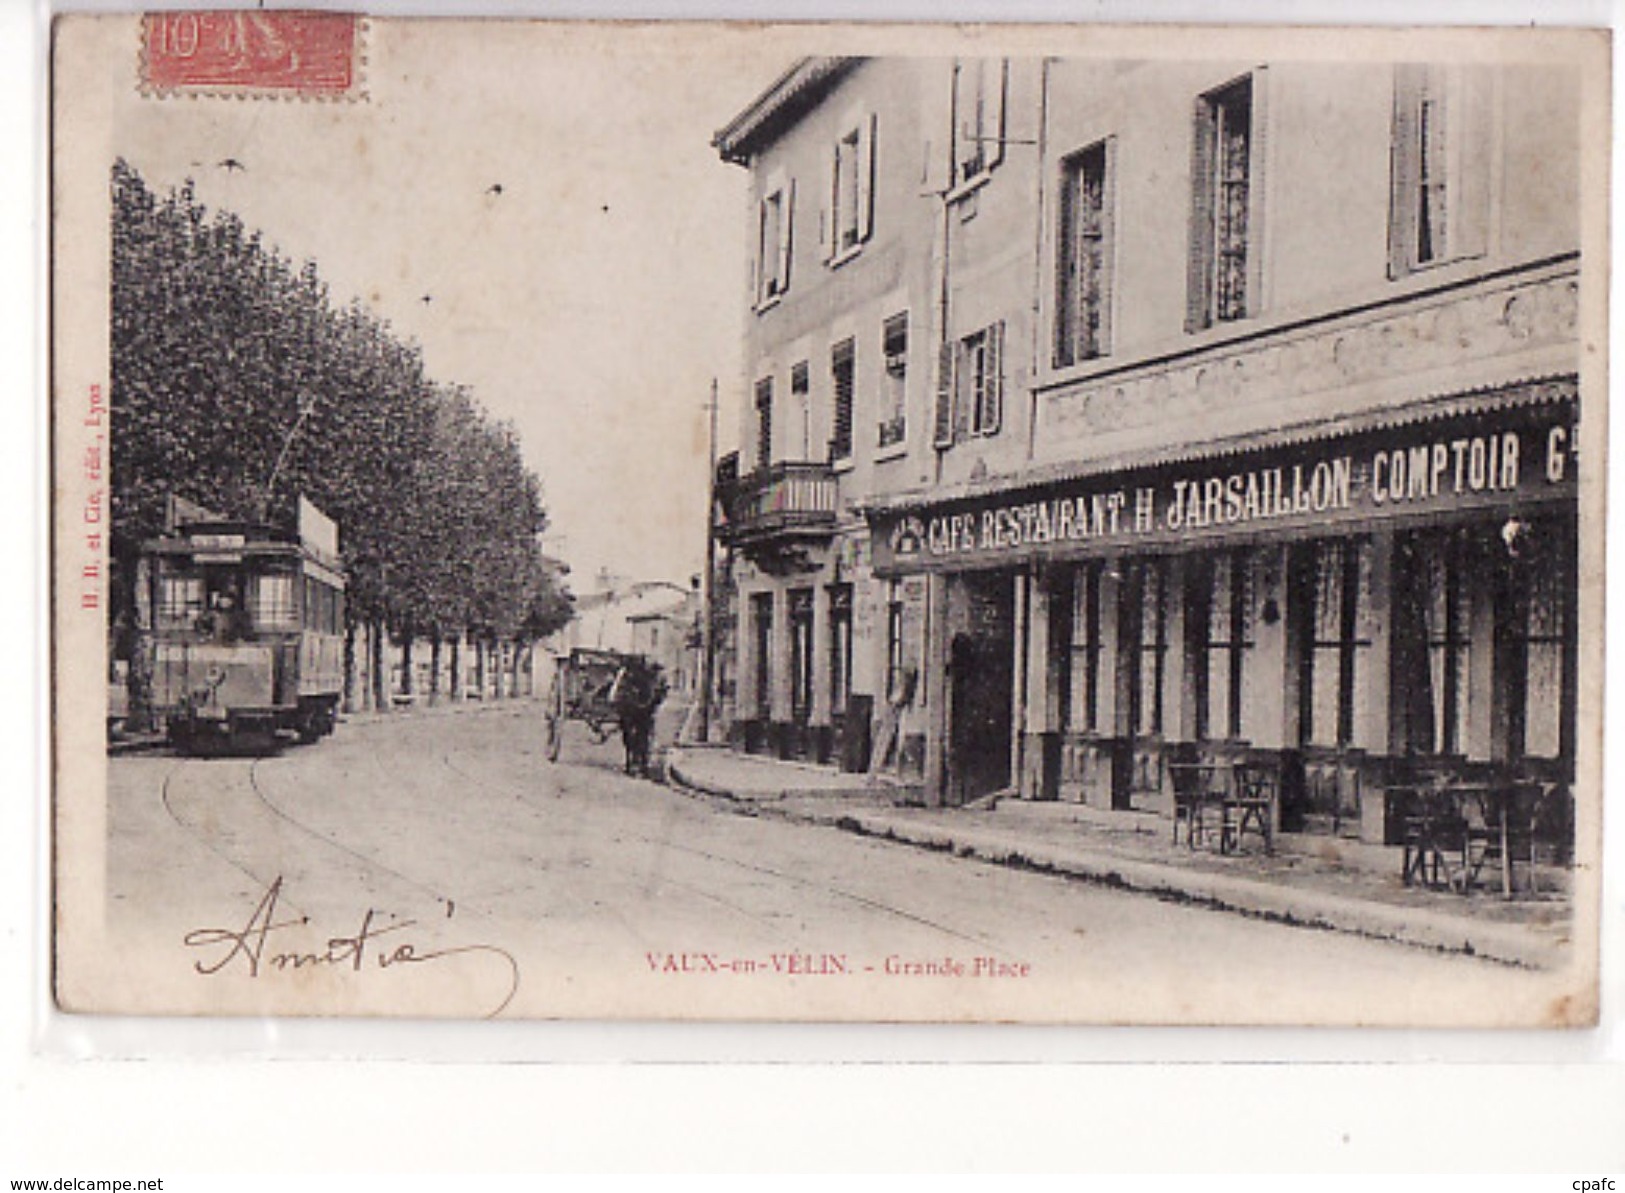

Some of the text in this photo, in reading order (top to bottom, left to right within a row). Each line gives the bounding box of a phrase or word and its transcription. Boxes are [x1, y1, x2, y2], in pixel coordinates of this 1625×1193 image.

[84, 384, 107, 426] Lyon
[1167, 456, 1351, 531] JARSAILLON
[1373, 431, 1519, 502] COMPTOIR
